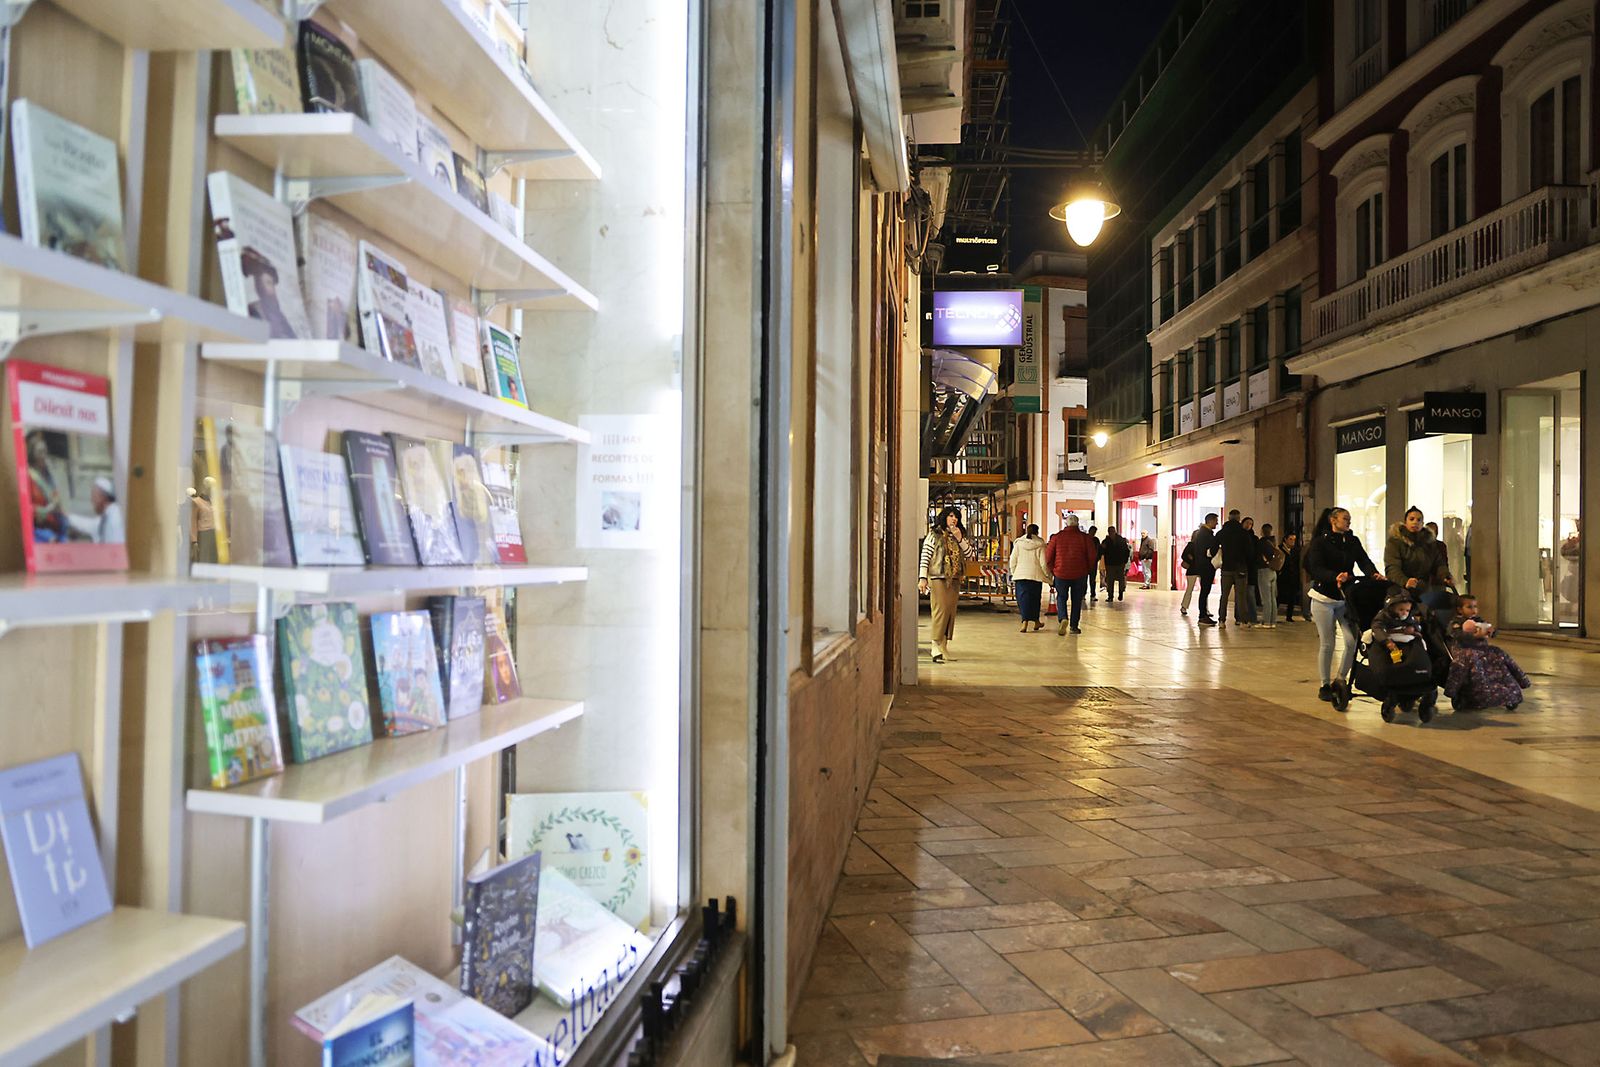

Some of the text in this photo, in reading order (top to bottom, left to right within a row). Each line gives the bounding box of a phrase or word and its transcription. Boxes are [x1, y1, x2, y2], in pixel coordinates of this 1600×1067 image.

[1026, 314, 1034, 363] INDUSTRIAL
[1431, 408, 1482, 418] MANGO
[1341, 425, 1382, 446] MANGO
[591, 454, 639, 464] RECORTES
[592, 474, 633, 484] FORMAS
[342, 1034, 410, 1067] RINCIPITO
